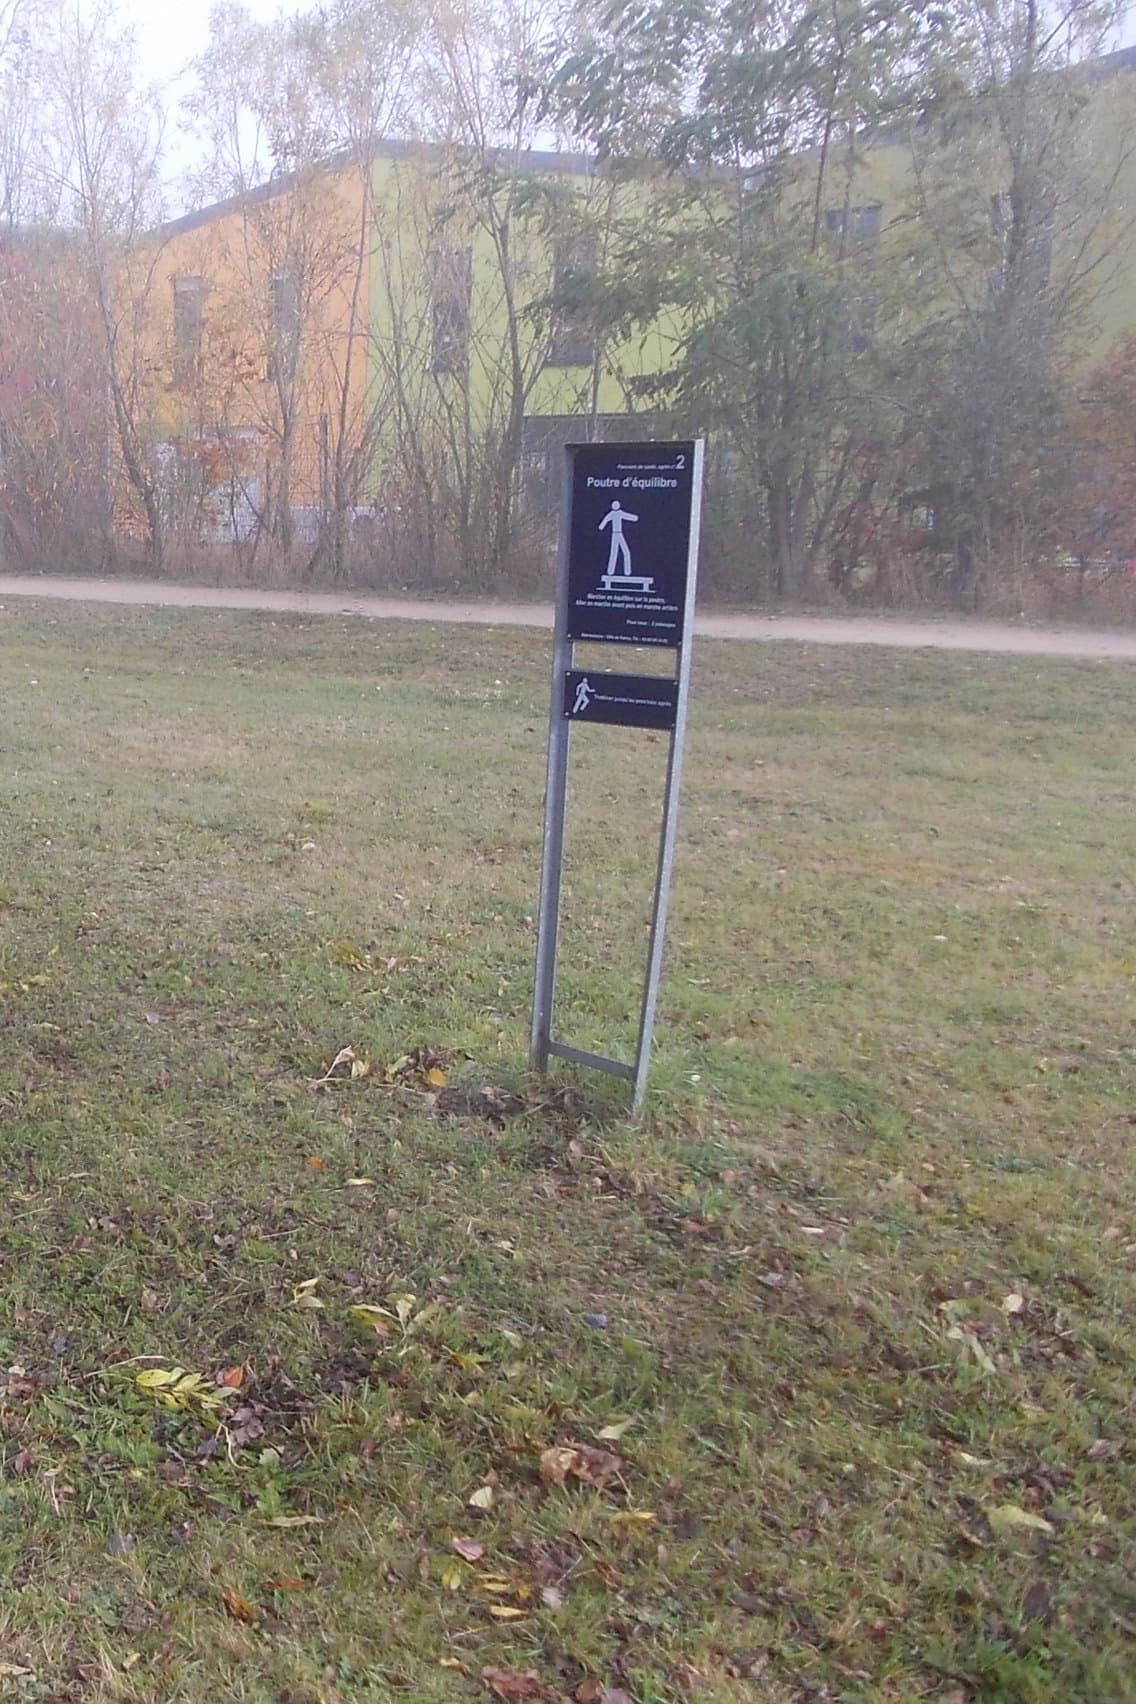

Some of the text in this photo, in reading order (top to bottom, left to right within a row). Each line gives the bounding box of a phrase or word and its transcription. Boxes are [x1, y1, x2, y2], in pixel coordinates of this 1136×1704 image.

[676, 454, 685, 470] 2
[587, 476, 678, 490] Poutre d'équilibre
